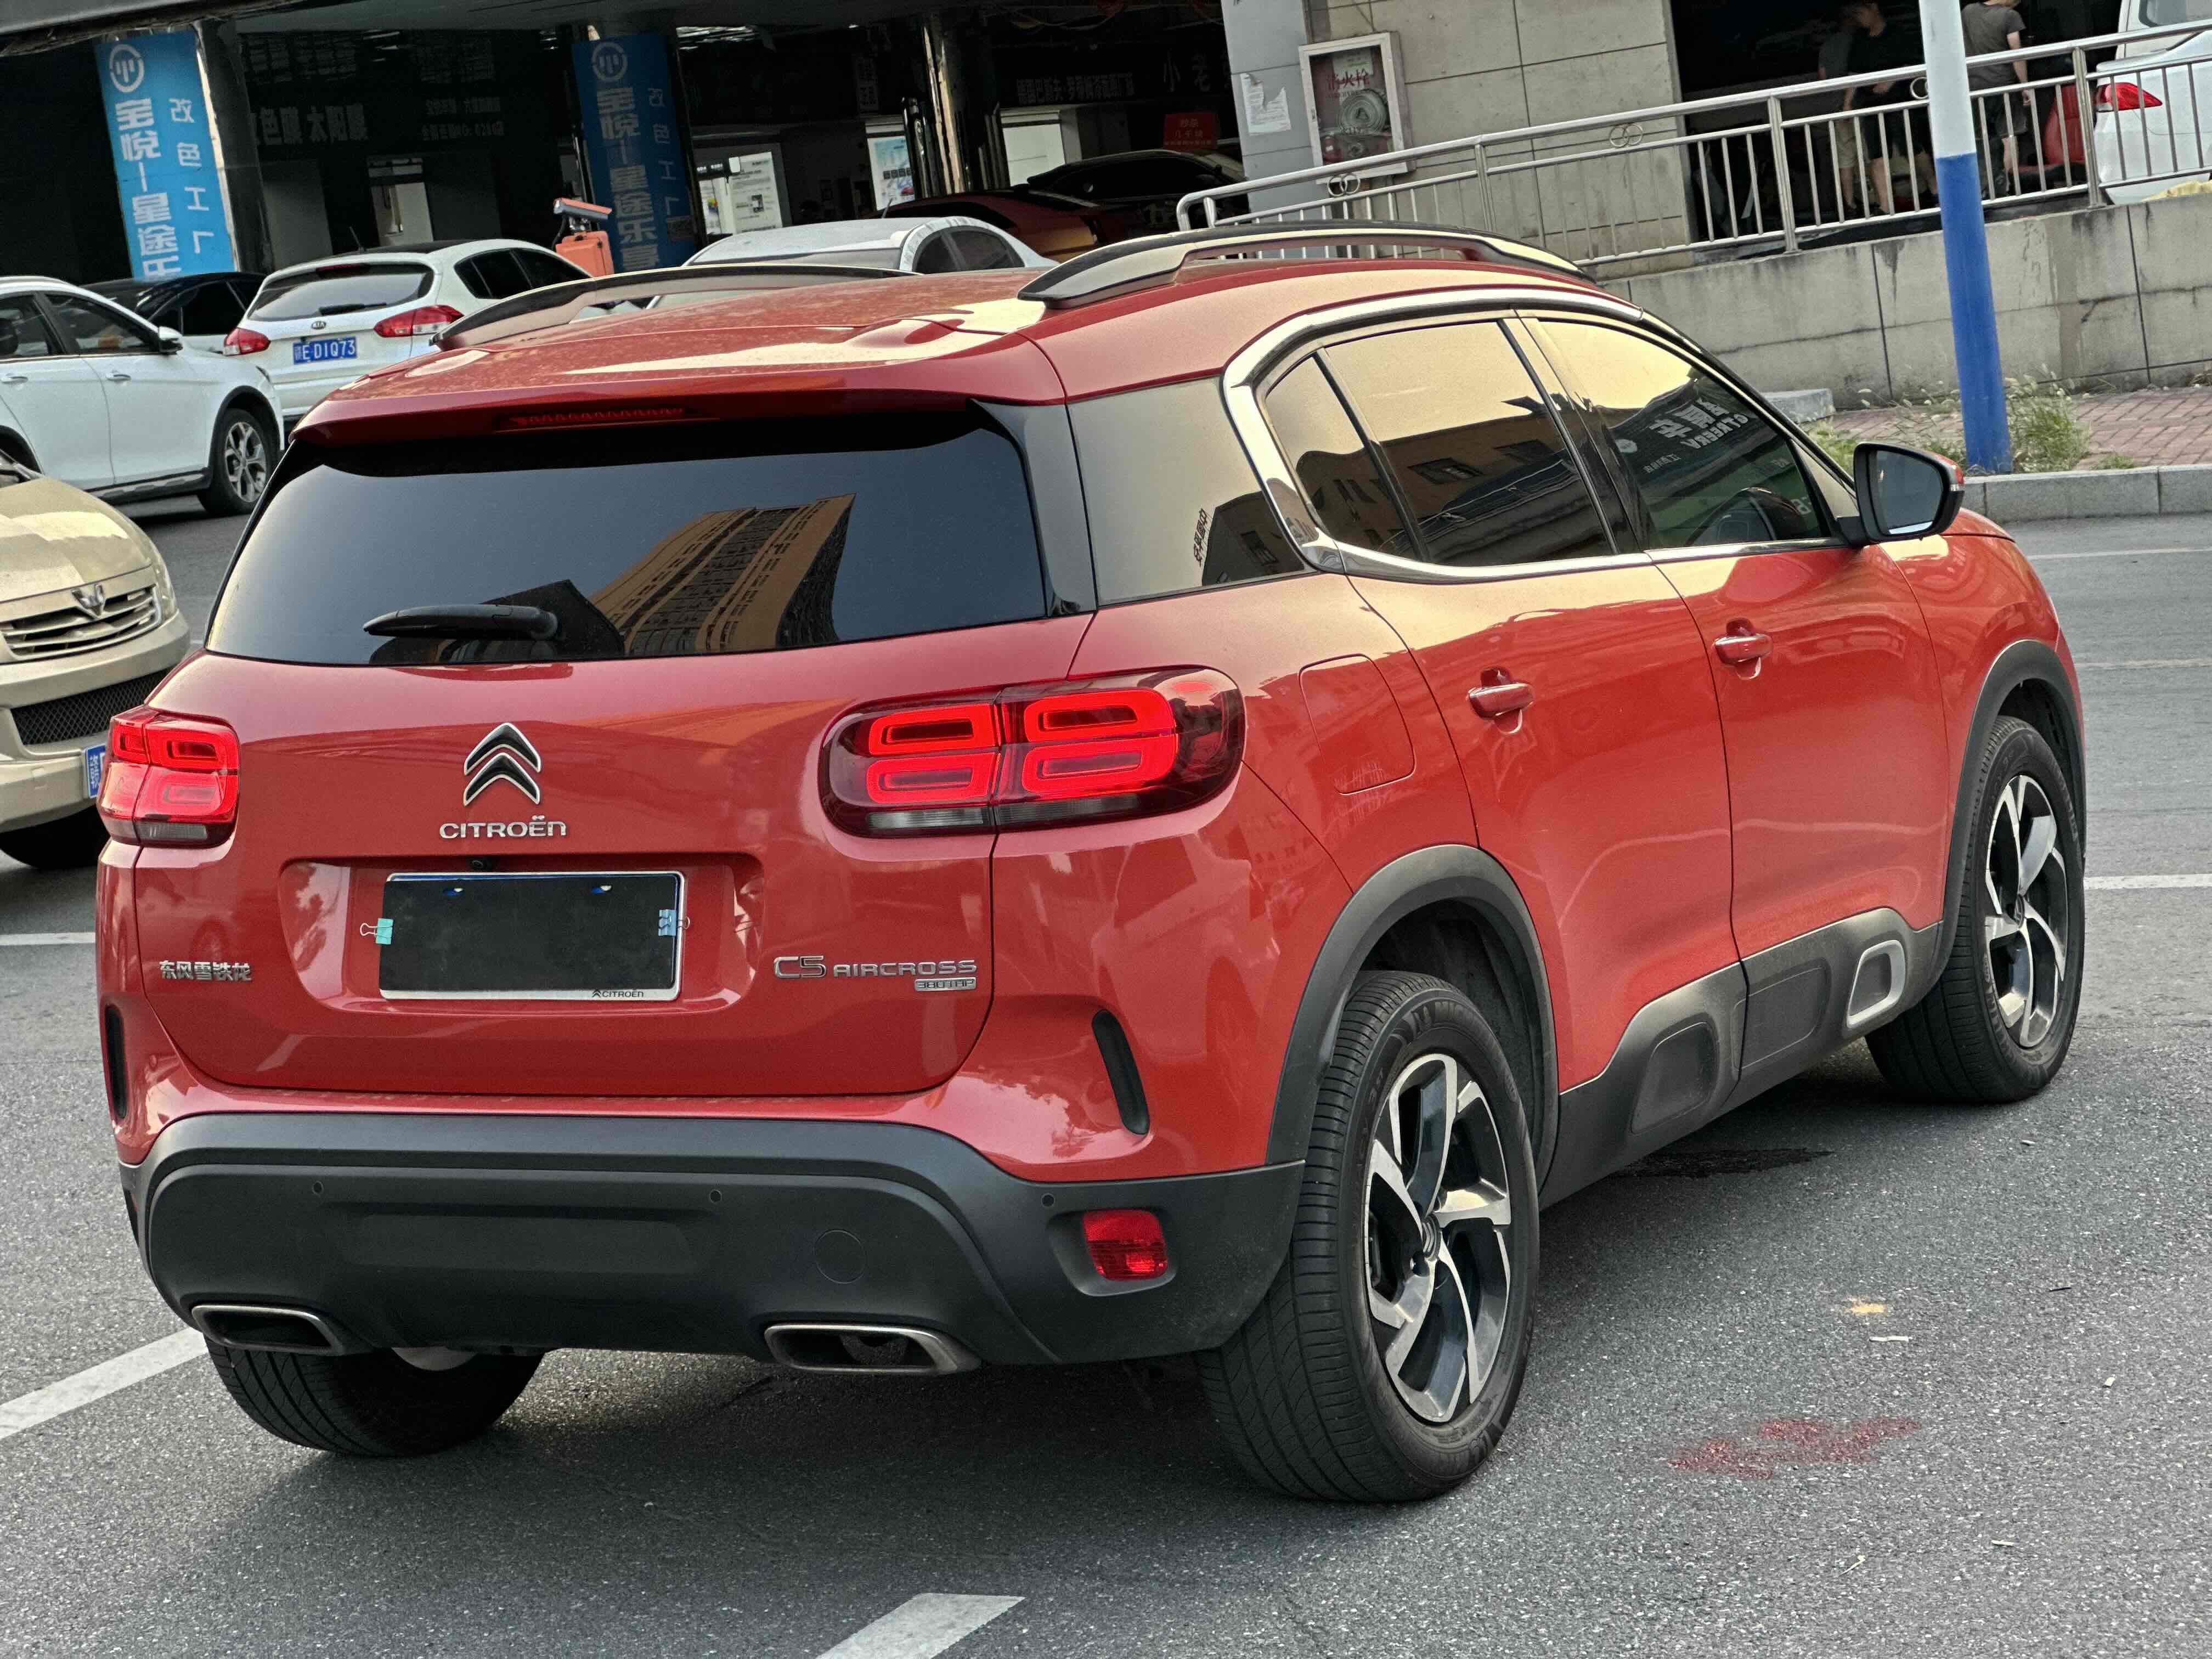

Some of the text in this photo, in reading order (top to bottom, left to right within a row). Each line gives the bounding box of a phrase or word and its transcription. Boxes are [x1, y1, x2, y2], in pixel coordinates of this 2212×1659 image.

[170, 98, 214, 254] 改色工厂
[159, 960, 252, 981] 东风雪铁龙
[774, 955, 977, 979] C5 AIRCROSS
